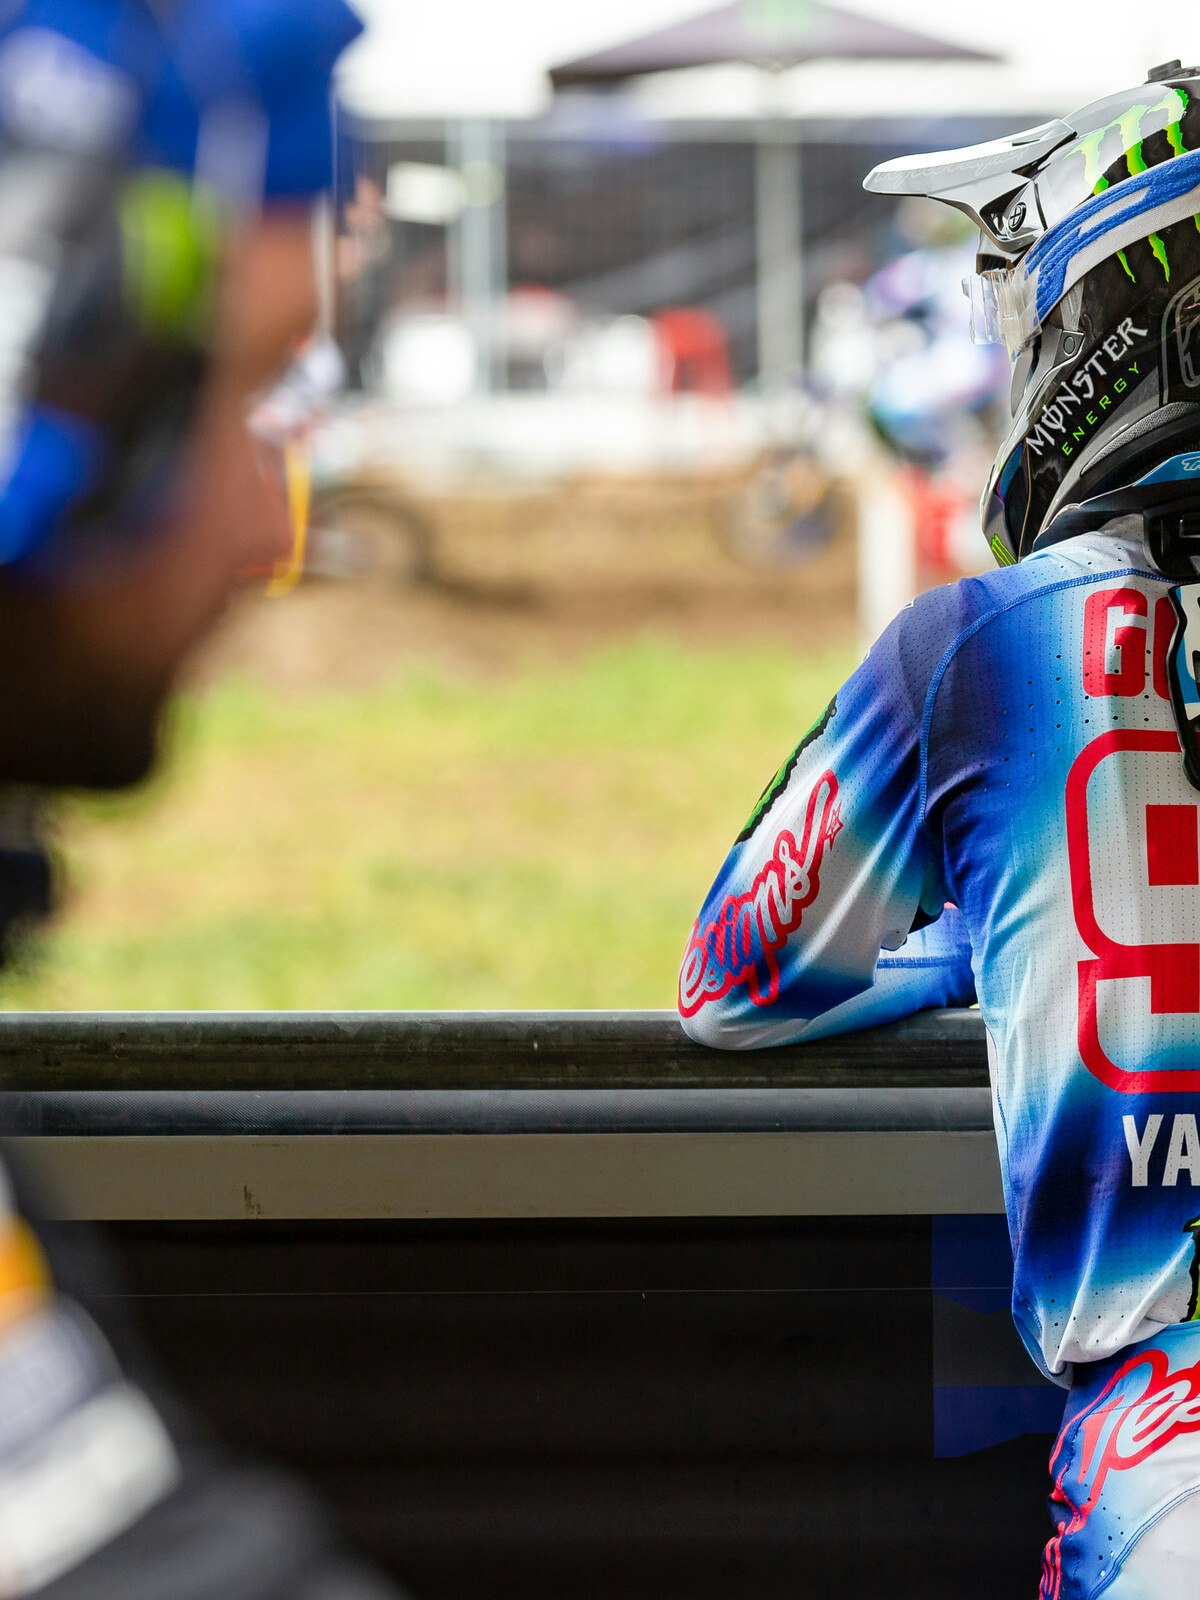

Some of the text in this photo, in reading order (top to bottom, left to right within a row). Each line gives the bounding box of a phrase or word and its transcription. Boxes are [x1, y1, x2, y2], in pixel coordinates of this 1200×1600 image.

[1025, 316, 1149, 456] MONSTER
[1061, 361, 1140, 456] ENERGY
[677, 768, 839, 1018] esigns
